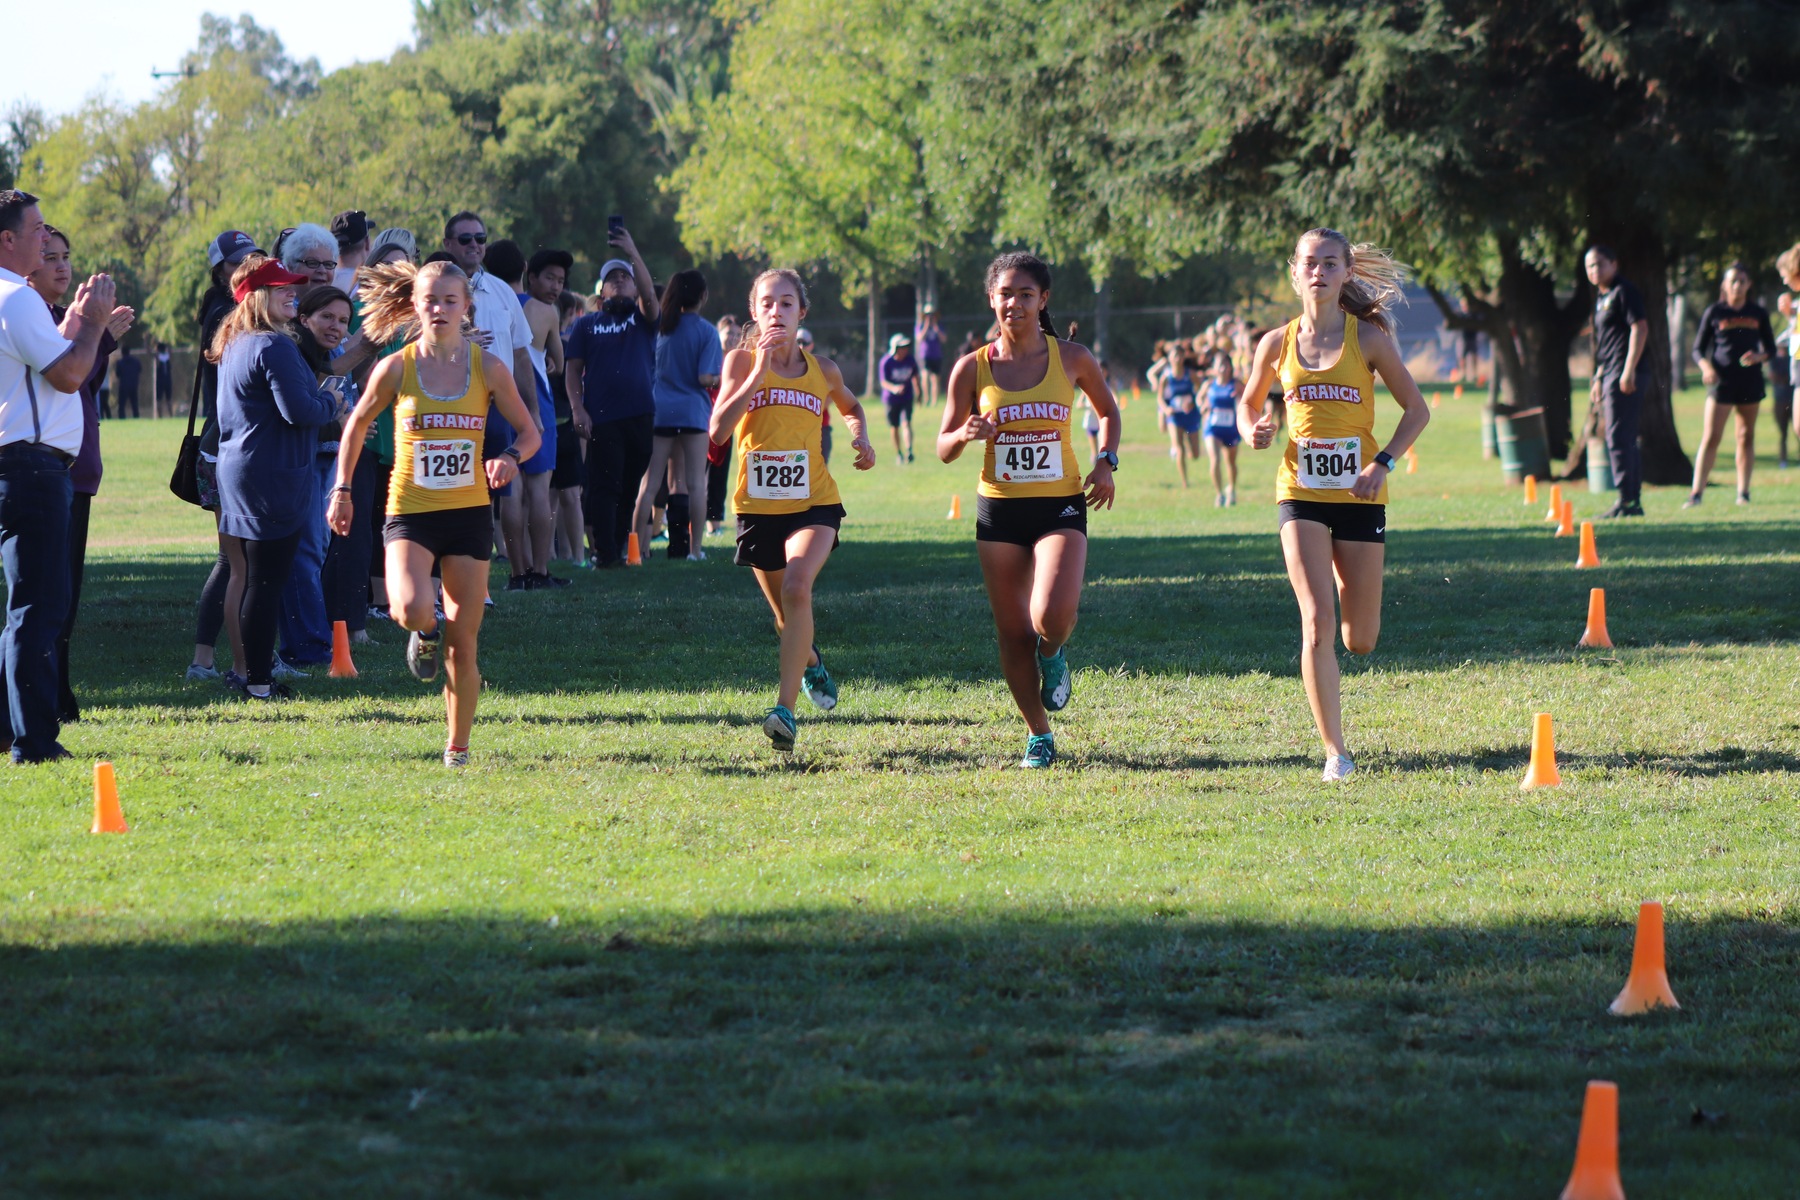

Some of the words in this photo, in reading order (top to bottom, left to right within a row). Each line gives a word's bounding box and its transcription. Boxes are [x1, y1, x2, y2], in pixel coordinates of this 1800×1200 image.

[593, 322, 628, 335] Hurley
[769, 388, 822, 416] FRANCIS
[1299, 384, 1361, 404] FRANCIS
[998, 403, 1070, 423] FRANCIS
[996, 431, 1058, 443] Athletic.net
[421, 453, 470, 477] 1292
[1005, 446, 1051, 471] 492
[1303, 453, 1358, 477] 1304
[754, 465, 805, 487] 1282
